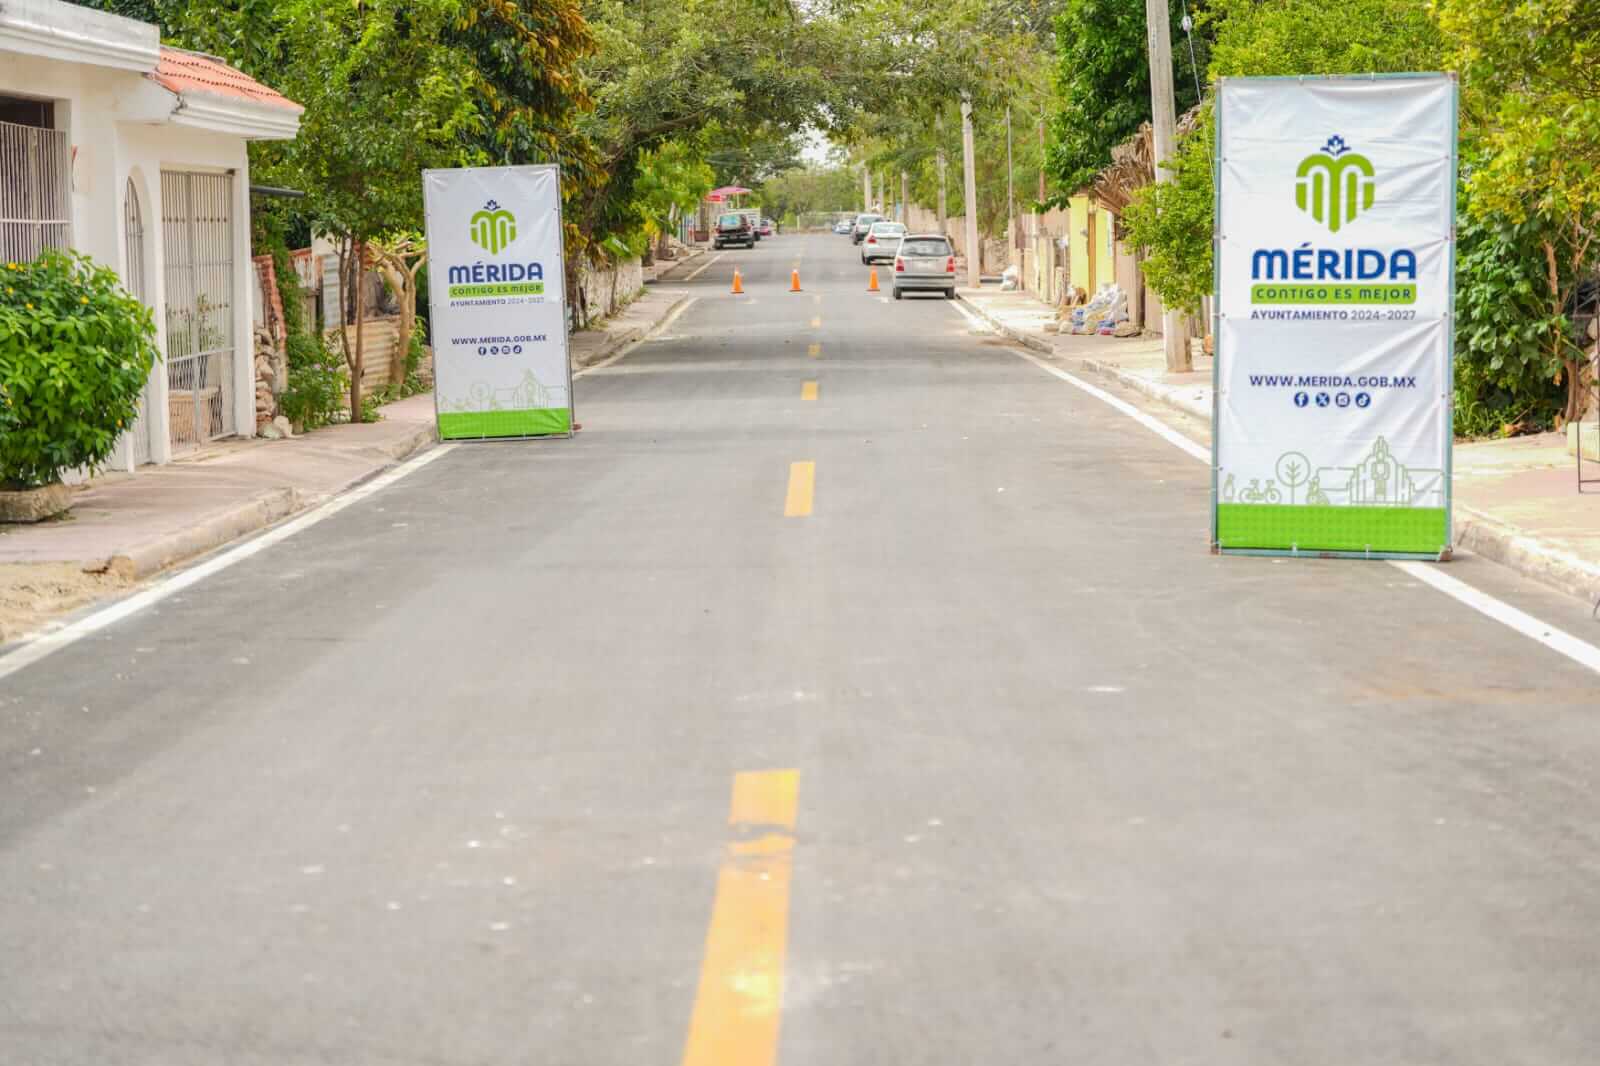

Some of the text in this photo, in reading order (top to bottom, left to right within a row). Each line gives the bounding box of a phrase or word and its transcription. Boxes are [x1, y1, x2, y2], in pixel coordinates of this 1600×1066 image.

[1252, 242, 1417, 280] MÉRIDA
[449, 261, 543, 284] MÉRIDA
[452, 285, 542, 296] CONTIGO ES MEJOR
[1256, 288, 1411, 302] CONTIGO ES MEJOR
[450, 299, 506, 307] AYUNTAMIENTO
[1251, 310, 1416, 321] AYUNTAMIENTO 2024-2027
[451, 335, 547, 346] WWW.MERIDA.GOB.MX
[1250, 376, 1416, 388] WWW.MERIDA.GOB.MX
